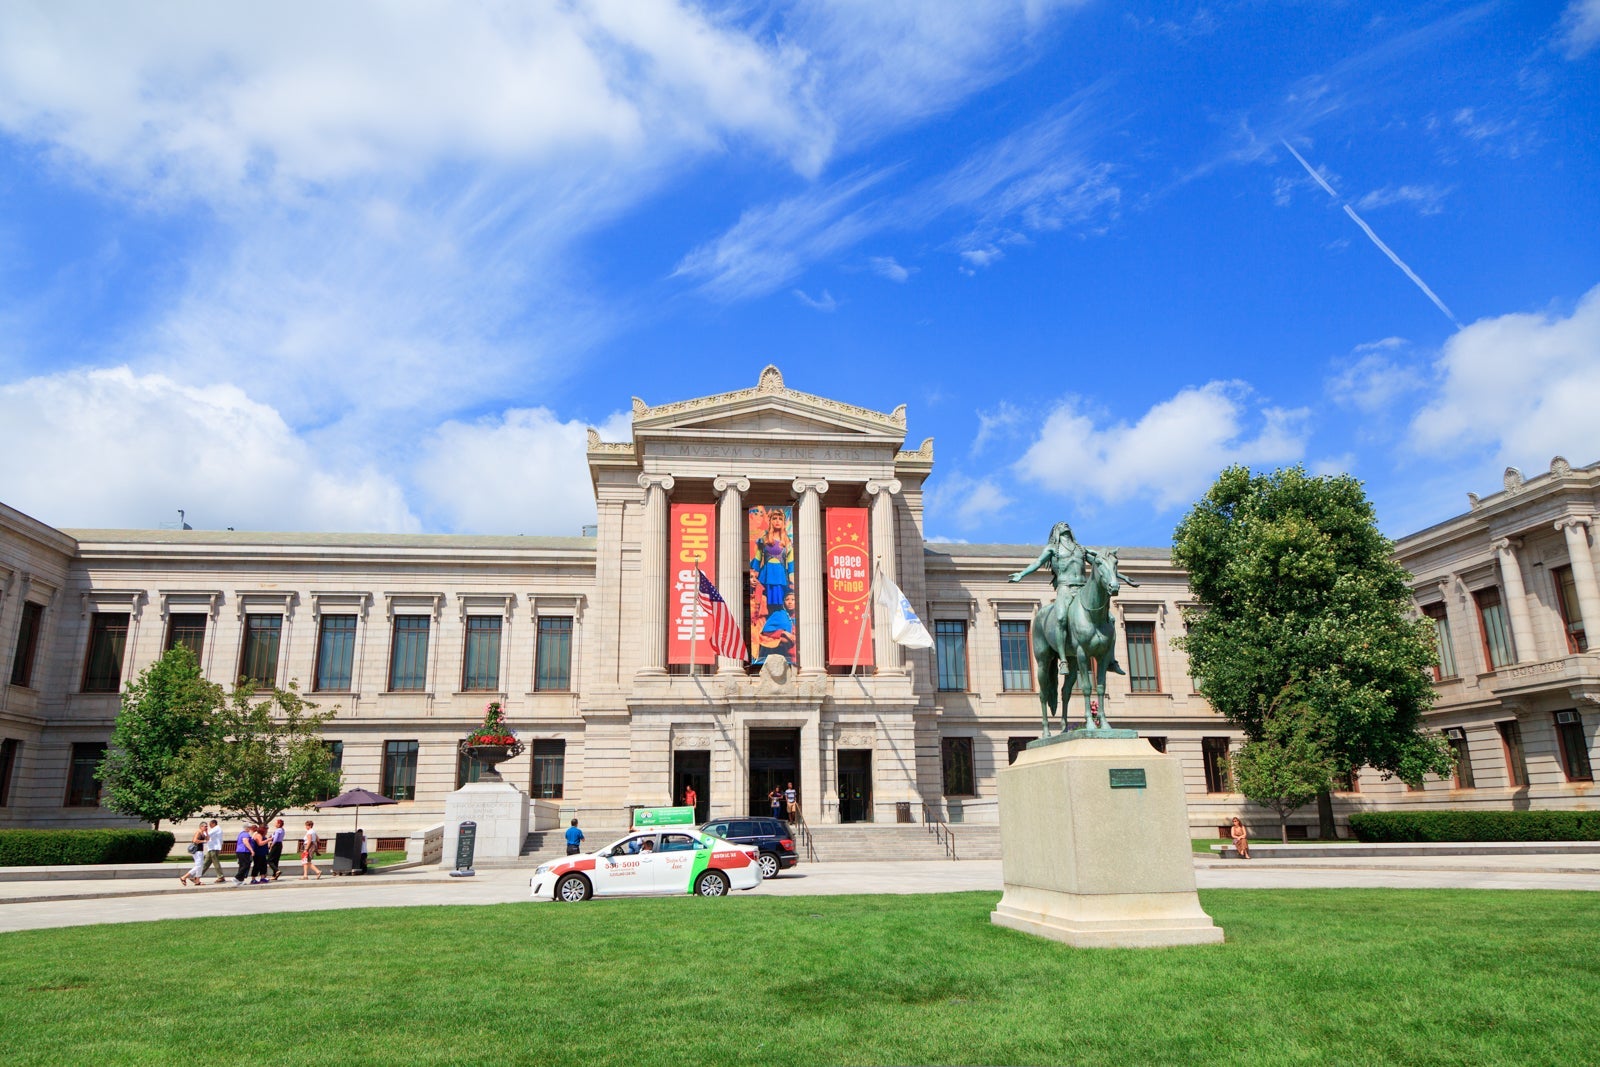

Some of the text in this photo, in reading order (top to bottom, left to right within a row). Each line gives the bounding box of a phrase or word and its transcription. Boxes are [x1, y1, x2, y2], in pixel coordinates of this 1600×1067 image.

[752, 447, 769, 458] OF
[780, 448, 815, 459] FINE
[824, 449, 860, 459] ARTS
